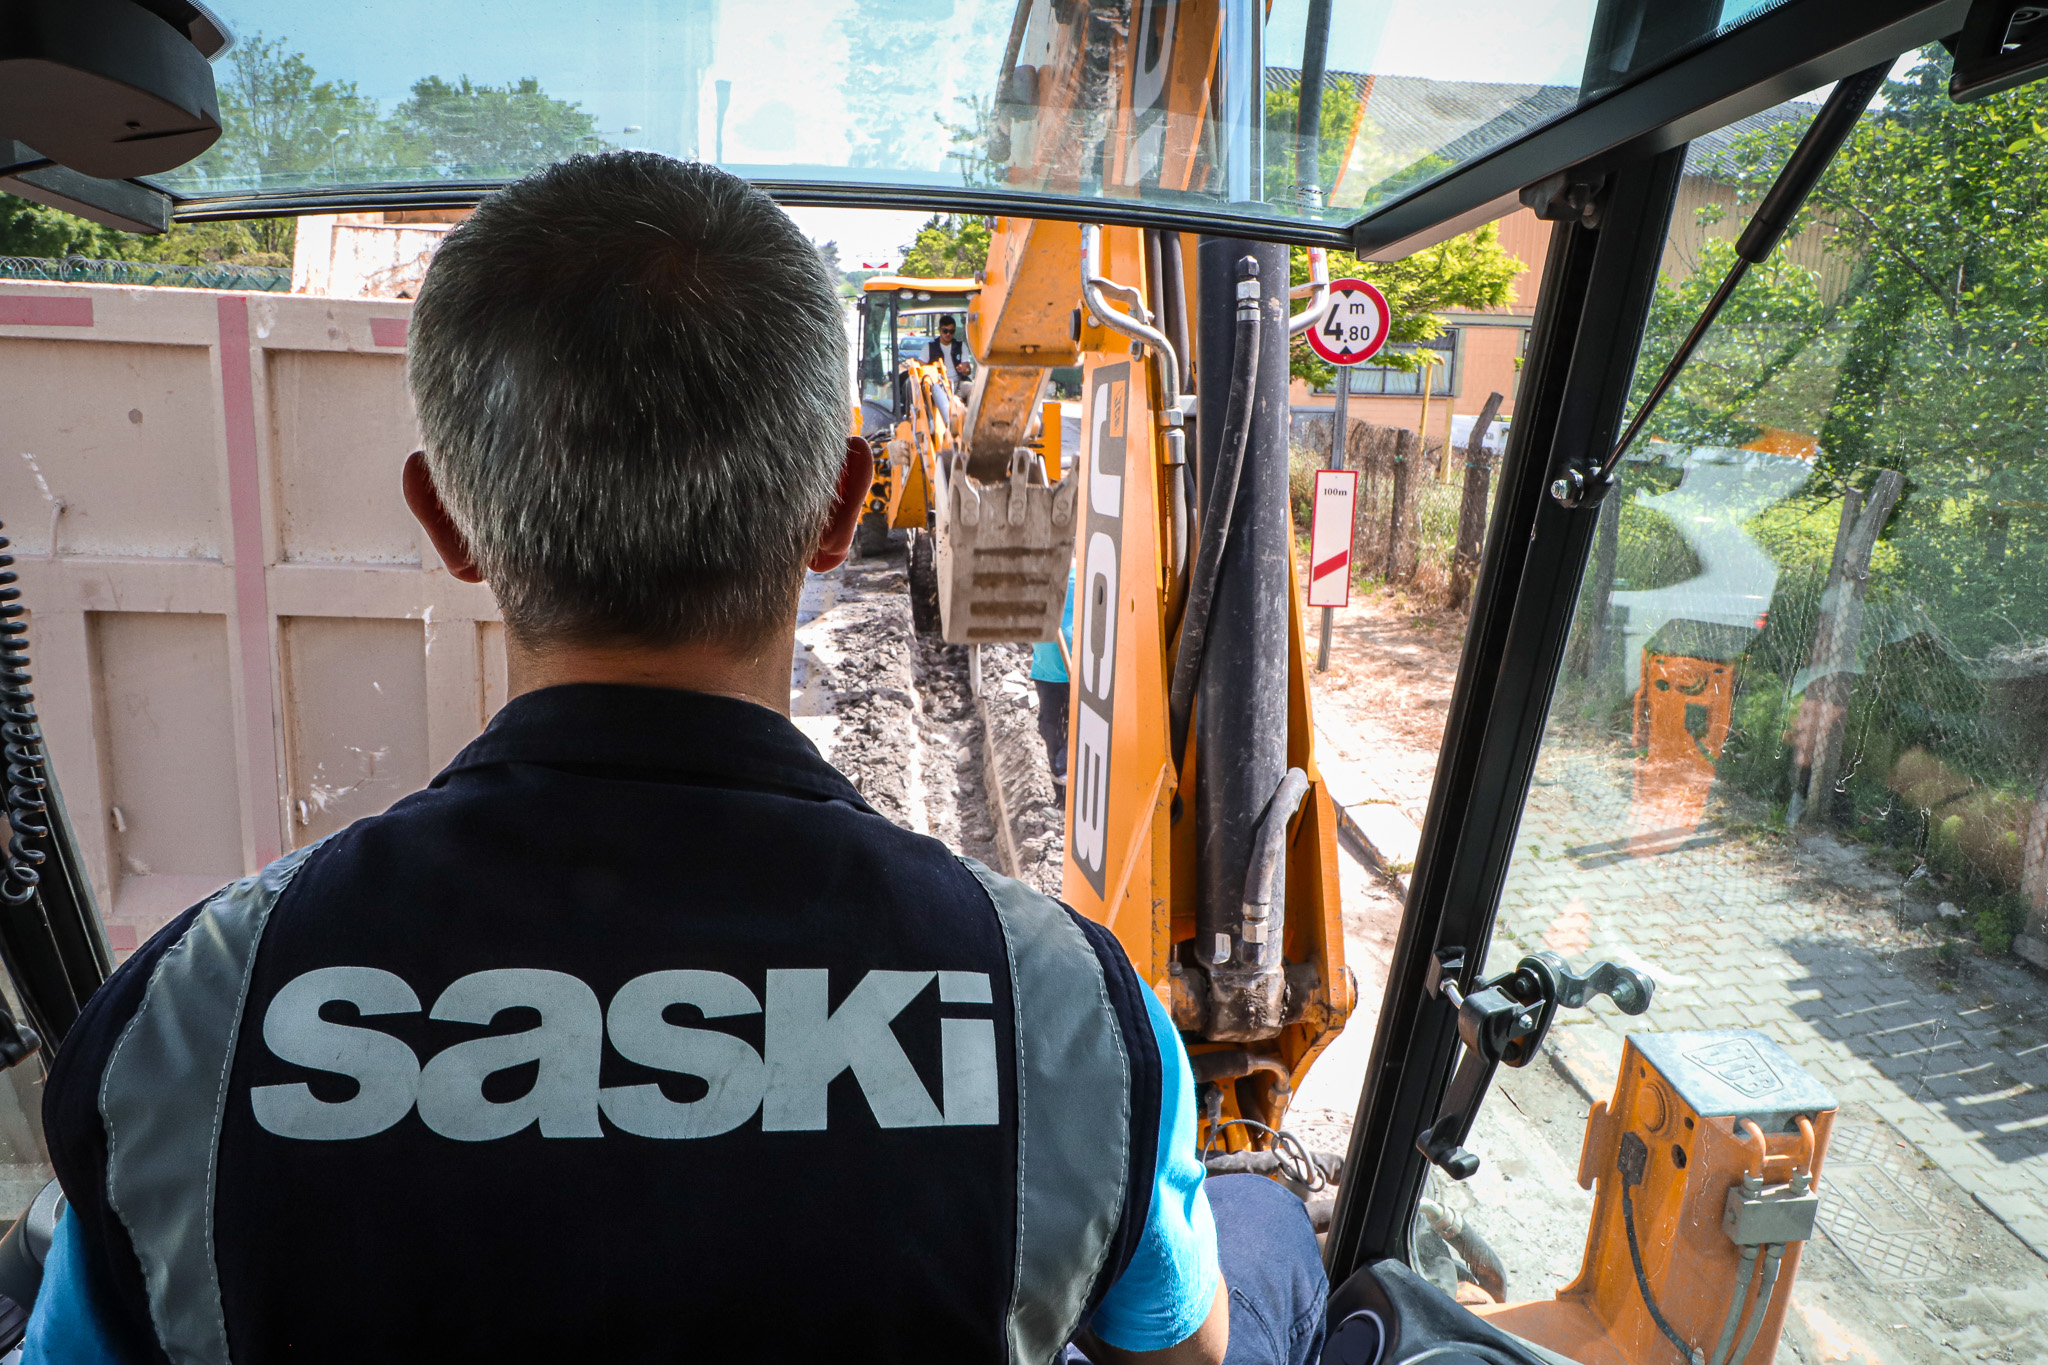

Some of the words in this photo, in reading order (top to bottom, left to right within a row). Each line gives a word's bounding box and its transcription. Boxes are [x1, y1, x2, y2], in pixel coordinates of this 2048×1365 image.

[1350, 303, 1365, 314] m
[1324, 487, 1347, 496] 100m
[1076, 382, 1121, 872] JCB
[1691, 1046, 1776, 1093] JCB
